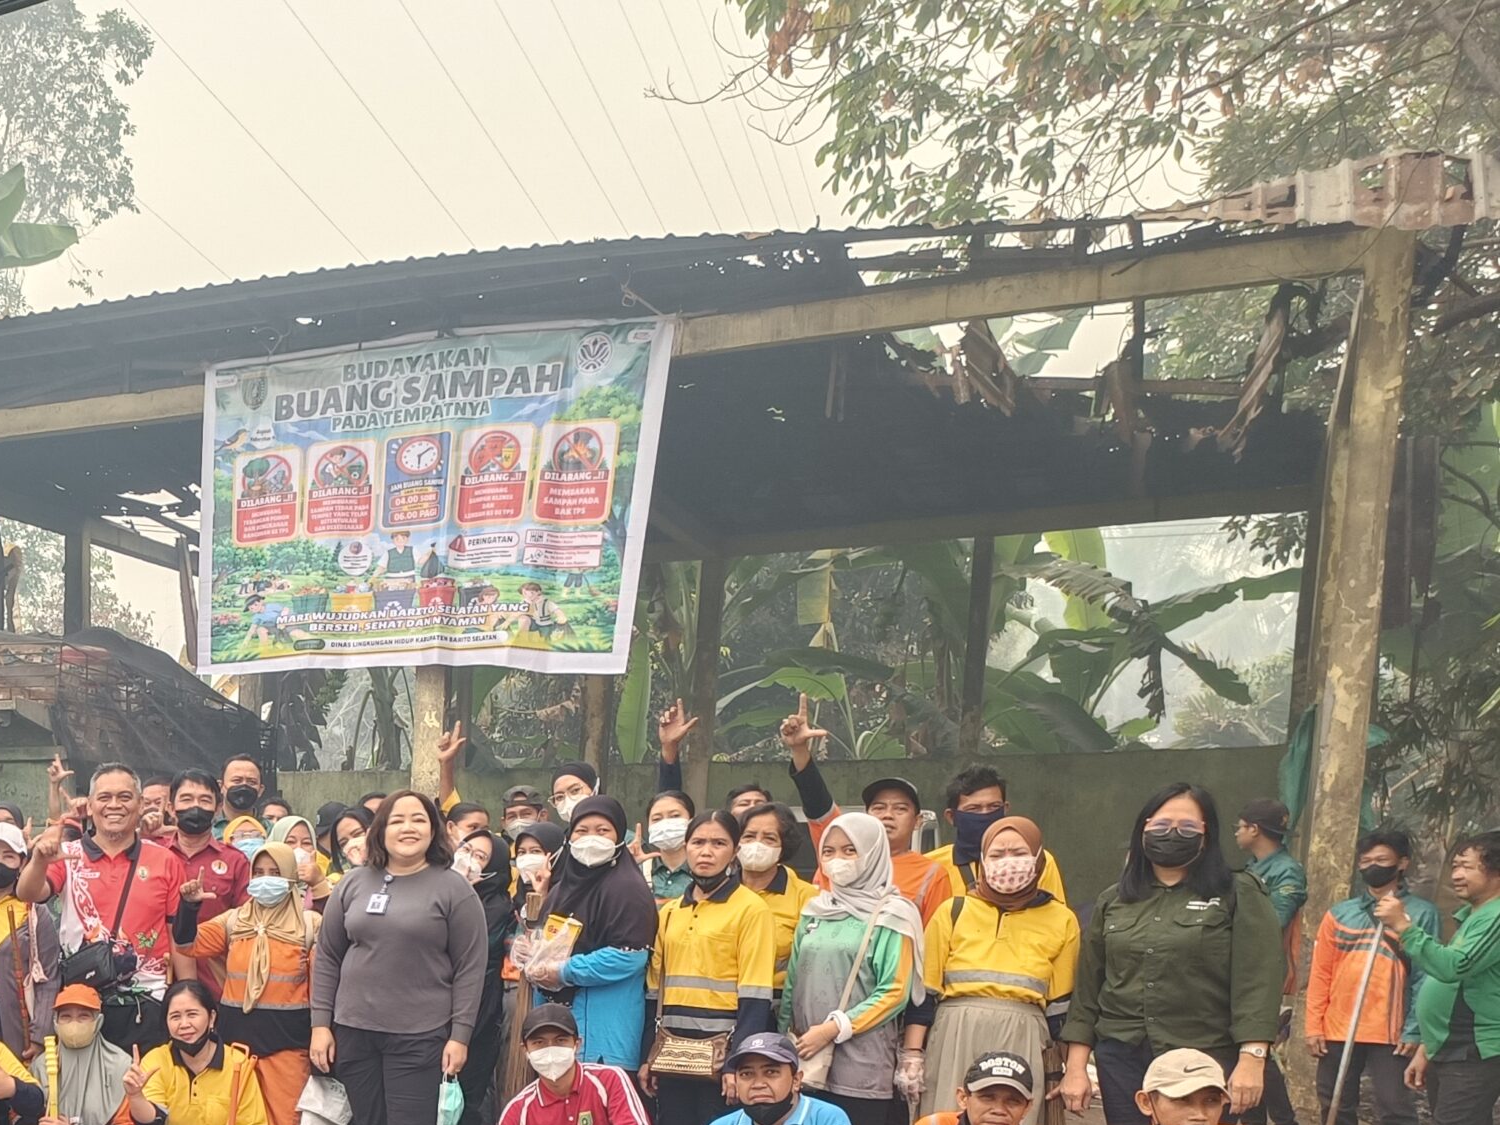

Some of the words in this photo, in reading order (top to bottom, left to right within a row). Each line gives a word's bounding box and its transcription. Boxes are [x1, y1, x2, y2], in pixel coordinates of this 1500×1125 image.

[342, 346, 490, 383] BUDAYAKAN
[274, 380, 393, 422] BUANG
[401, 363, 562, 404] SAMPAH
[331, 414, 379, 432] PADA
[384, 400, 490, 426] TEMPATNYA
[464, 473, 509, 485] DILARANG
[544, 471, 592, 482] DILARANG
[312, 487, 358, 498] DILARANG
[241, 496, 282, 508] DILARANG
[542, 496, 577, 506] SAMPAH
[578, 496, 600, 505] PADA
[394, 511, 418, 521] 06.00
[420, 508, 437, 518] PAGI
[468, 535, 513, 546] PERINGATAN
[276, 613, 310, 625] MARI
[311, 609, 386, 622] WUJUDKAN
[390, 606, 436, 618] BARITO
[437, 604, 490, 615] SELATAN
[490, 602, 530, 613] YANG
[363, 620, 402, 631] SEHAT
[405, 618, 431, 628] DAN
[432, 616, 486, 627] NYAMAN
[330, 640, 352, 648] DINAS
[352, 639, 393, 648] LINGKUNGAN
[394, 638, 414, 646] HIDUP
[415, 635, 449, 644] KABUPATEN
[450, 635, 471, 643] BARITO
[472, 634, 498, 642] SELATAN
[979, 1057, 1026, 1075] BOSTON
